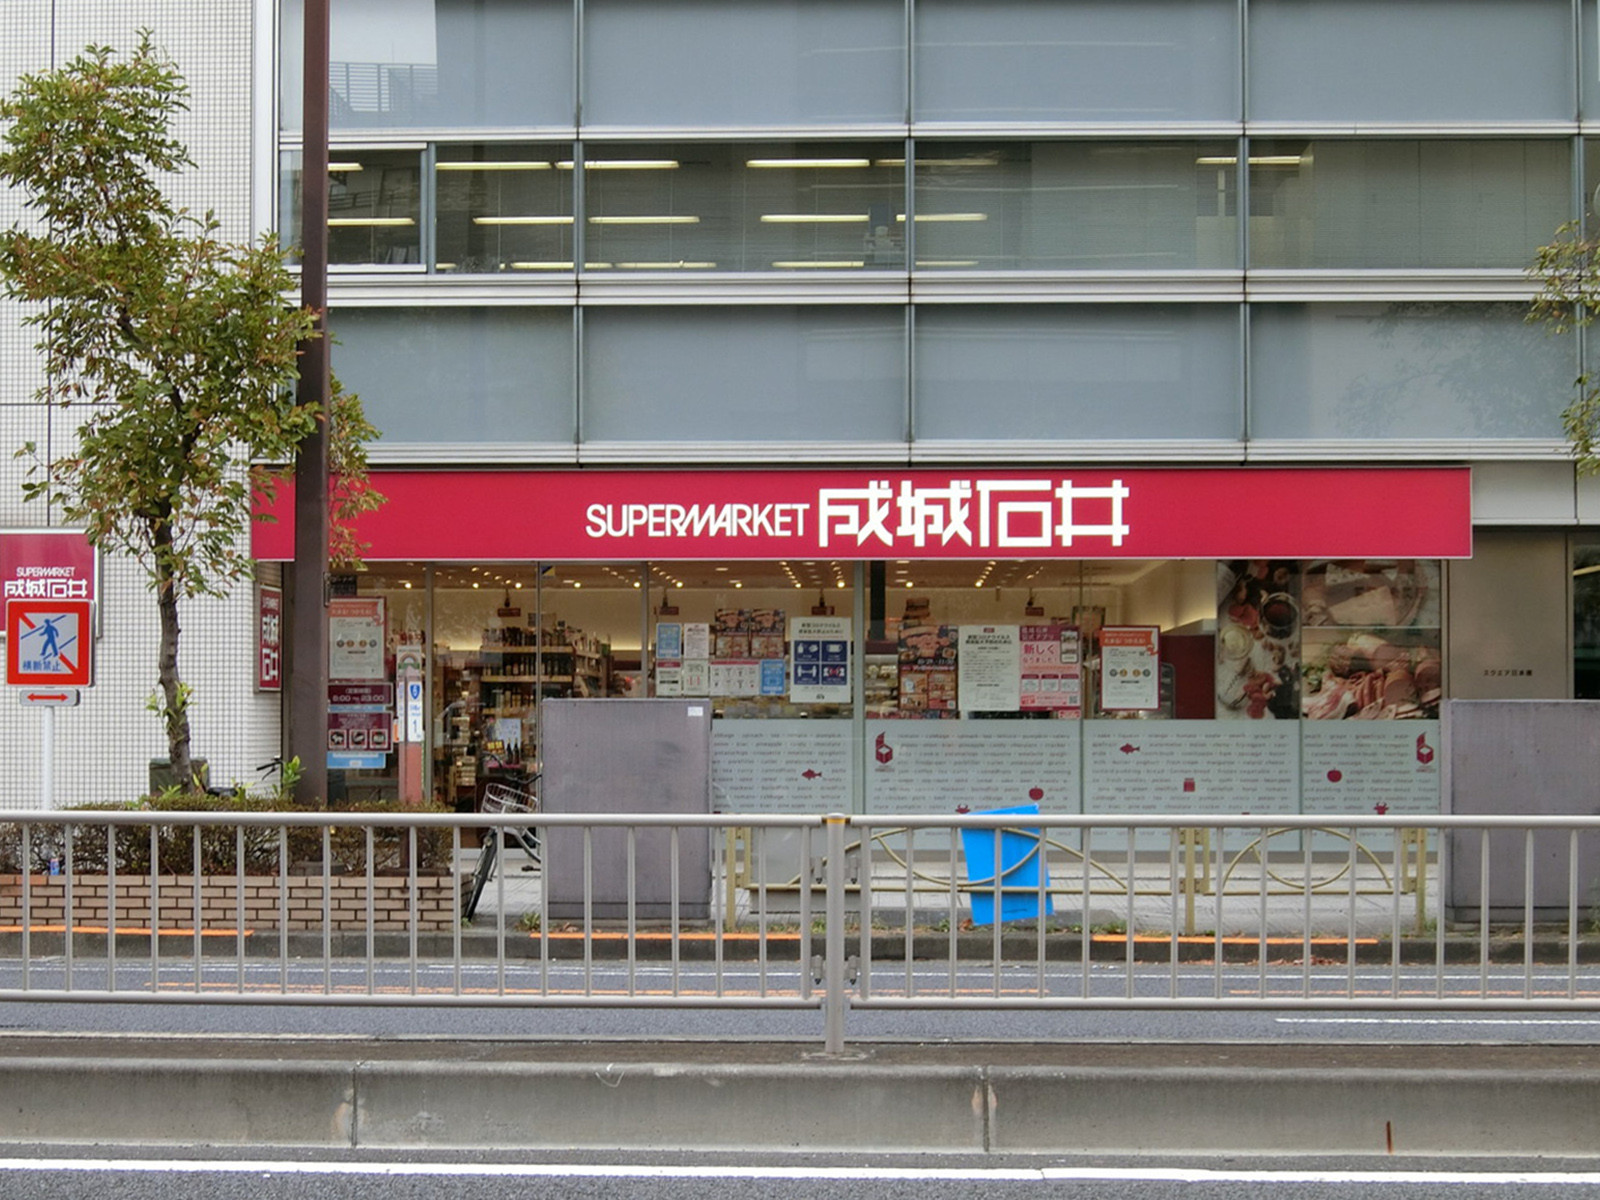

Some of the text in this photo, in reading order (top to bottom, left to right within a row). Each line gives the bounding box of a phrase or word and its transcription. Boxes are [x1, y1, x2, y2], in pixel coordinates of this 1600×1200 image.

[585, 479, 1130, 548] SUPERMARKET 成城石井
[16, 566, 75, 577] SUPERMARKET
[4, 579, 87, 598] 成城石井
[1024, 644, 1055, 654] 新しく
[22, 661, 60, 672] 横断禁止
